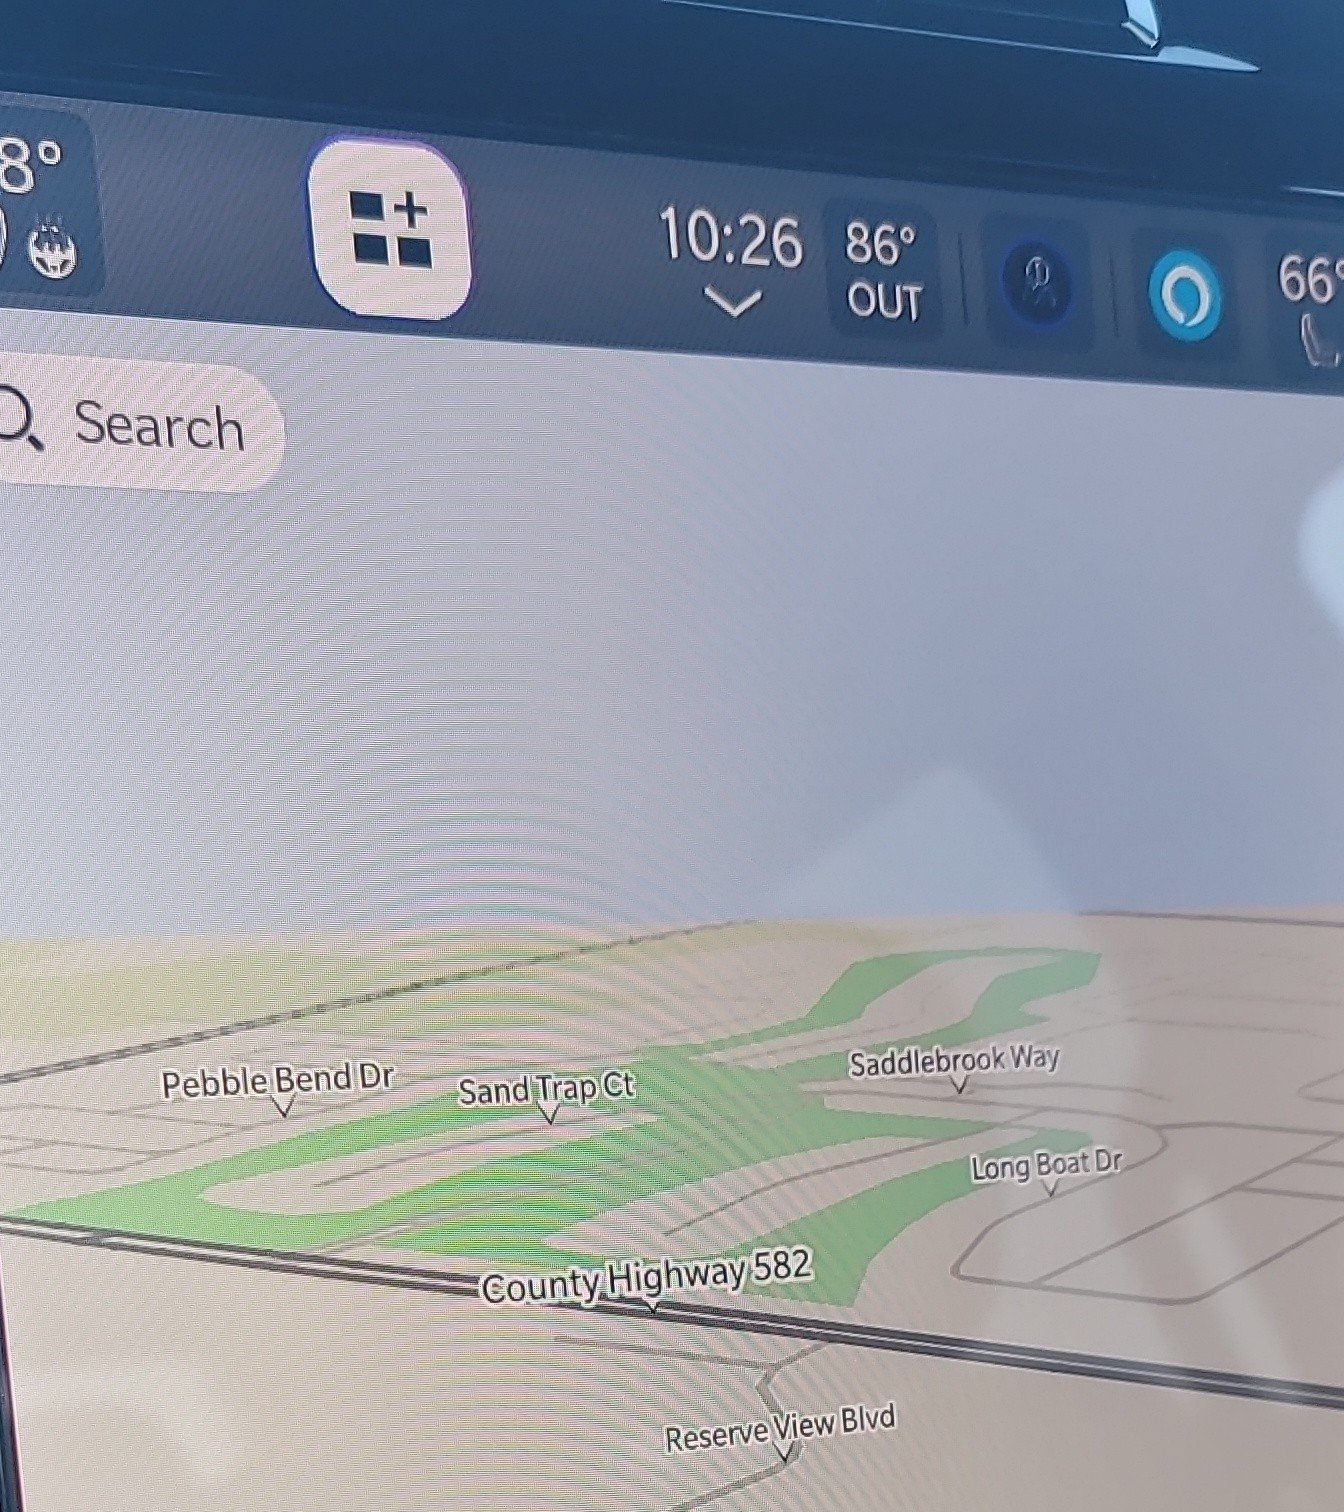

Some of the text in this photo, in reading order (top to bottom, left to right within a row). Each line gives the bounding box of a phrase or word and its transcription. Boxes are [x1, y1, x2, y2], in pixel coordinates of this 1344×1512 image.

[659, 204, 805, 270] 10:26
[847, 281, 925, 323] OUT
[74, 399, 246, 452] Search
[161, 1062, 396, 1098] Pebble Bend Dr
[850, 1044, 1061, 1077] Saddlebrook Way
[459, 1070, 635, 1105] Sand Trap Ct
[971, 1148, 1124, 1183] Long Boat Dr
[481, 1248, 813, 1304] County Highway 582
[665, 1401, 896, 1453] Reserve View Blvd
